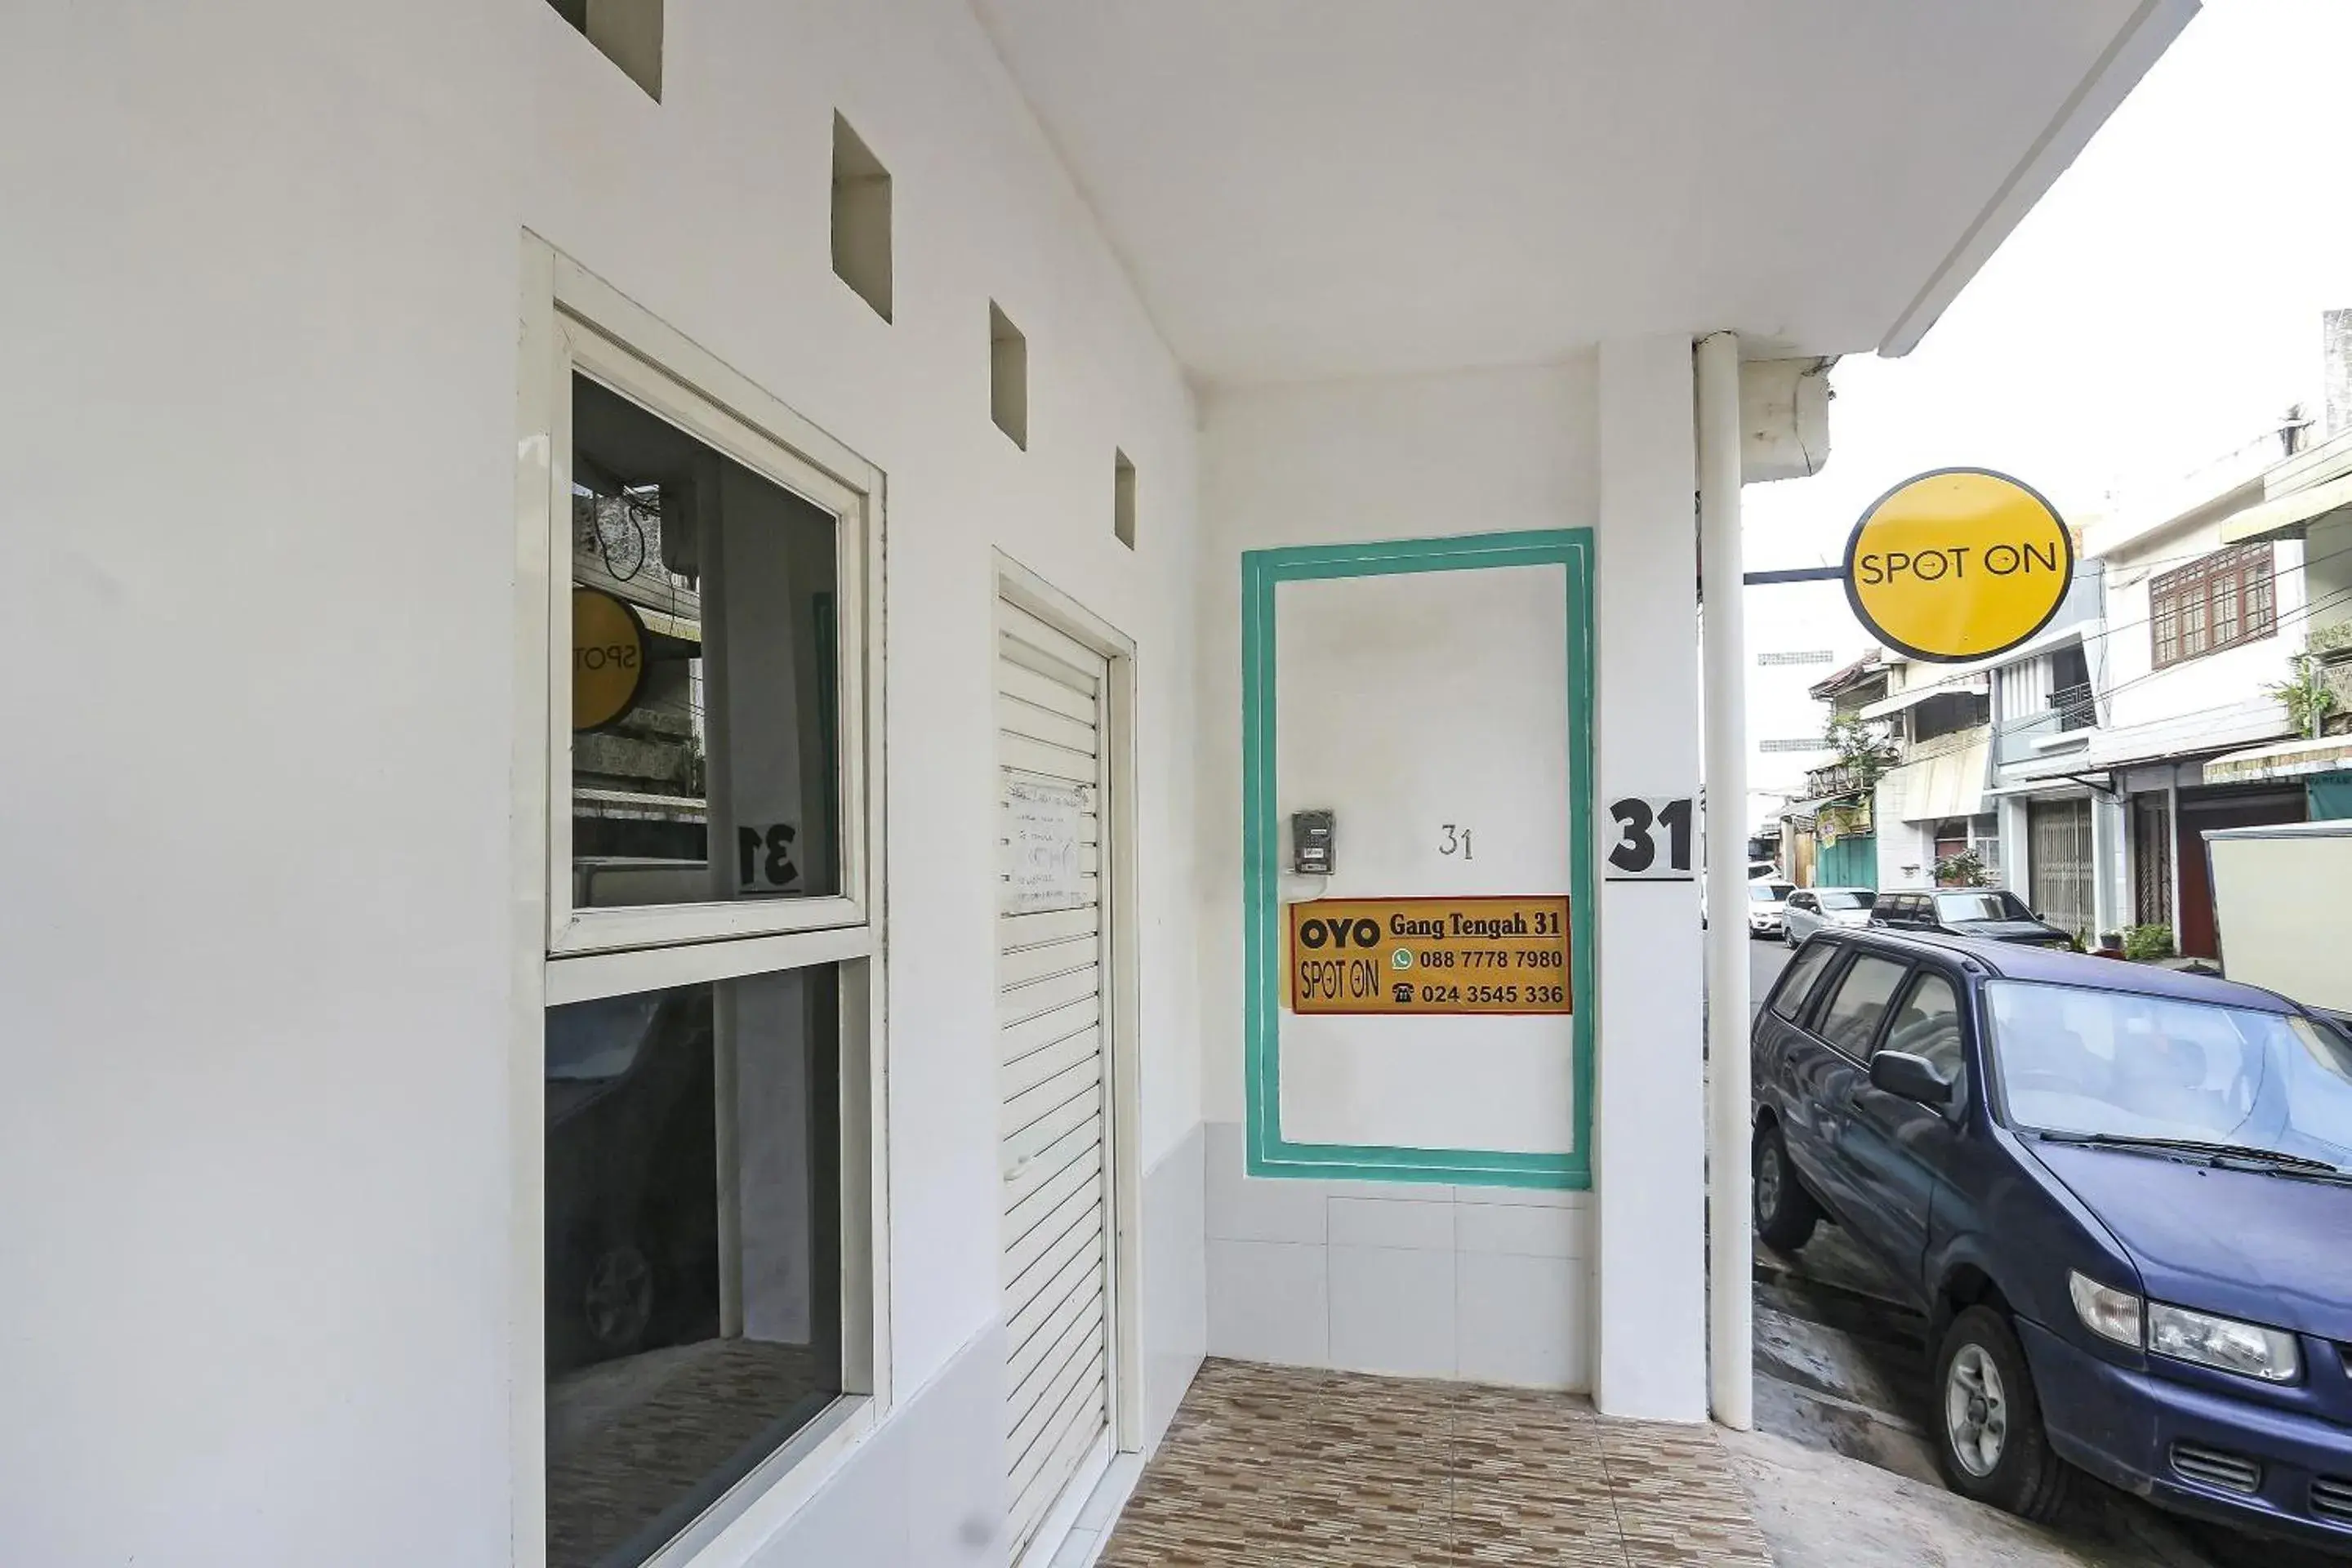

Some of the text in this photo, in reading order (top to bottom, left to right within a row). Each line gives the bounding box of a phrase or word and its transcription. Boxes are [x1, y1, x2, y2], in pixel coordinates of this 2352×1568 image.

[1861, 542, 2056, 585] SPOT ON
[1439, 824, 1472, 860] 31
[1608, 797, 1692, 872] 31
[1300, 918, 1380, 948] OYO
[1390, 911, 1560, 939] Gang Tengah 31
[1420, 951, 1562, 969] 088 7778 7980
[1301, 959, 1379, 999] SPOT ON
[1422, 986, 1563, 1003] 024 3545 336
